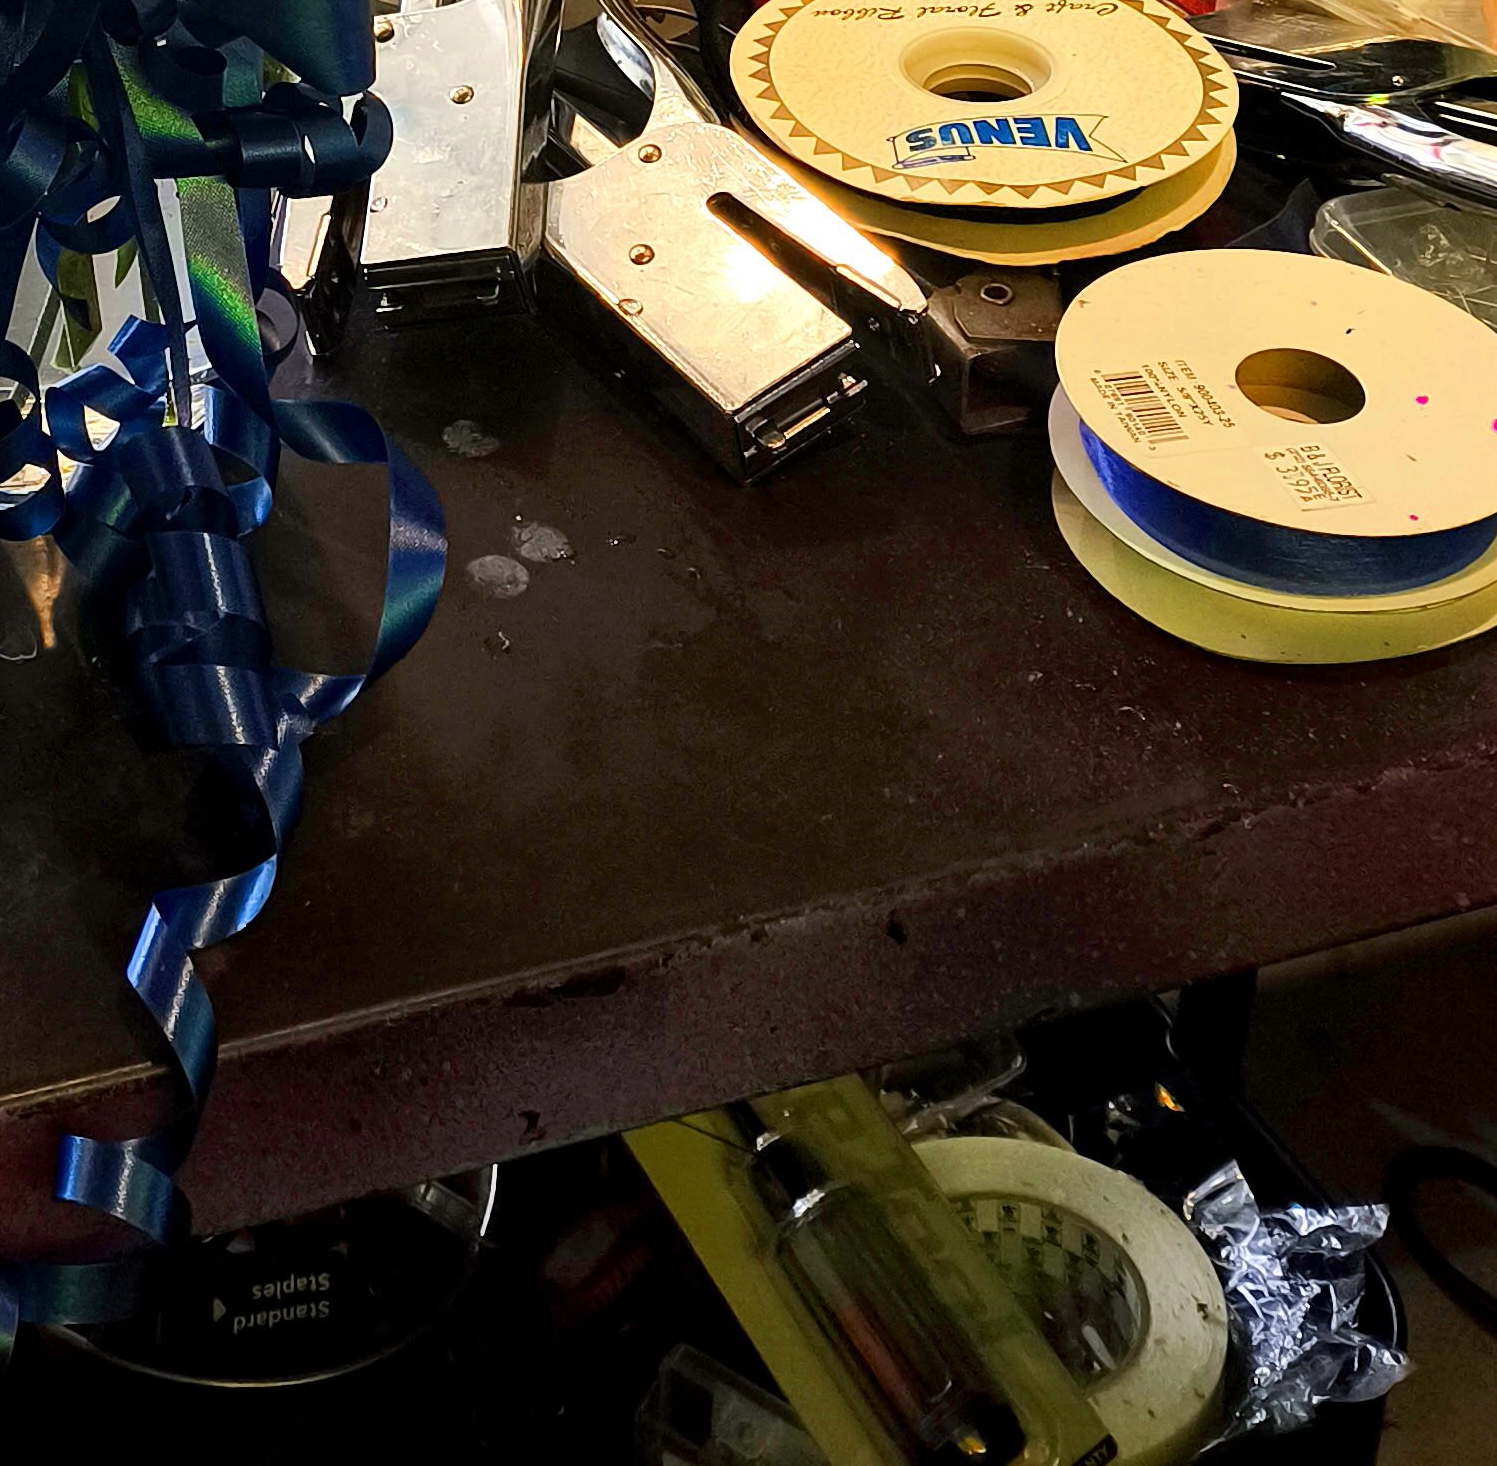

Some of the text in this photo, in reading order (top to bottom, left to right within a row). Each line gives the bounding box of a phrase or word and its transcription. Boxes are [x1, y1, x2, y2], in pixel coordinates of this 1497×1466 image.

[812, 0, 1118, 21] Craft & Floral Ribbon
[906, 117, 1092, 152] VENUS
[1158, 361, 1177, 380] SIZE
[1176, 359, 1196, 381] ITEM
[1090, 377, 1108, 399] MADE
[1115, 413, 1142, 443] TAIWAN
[252, 1273, 330, 1300] Staples
[233, 1301, 330, 1335] Standard
